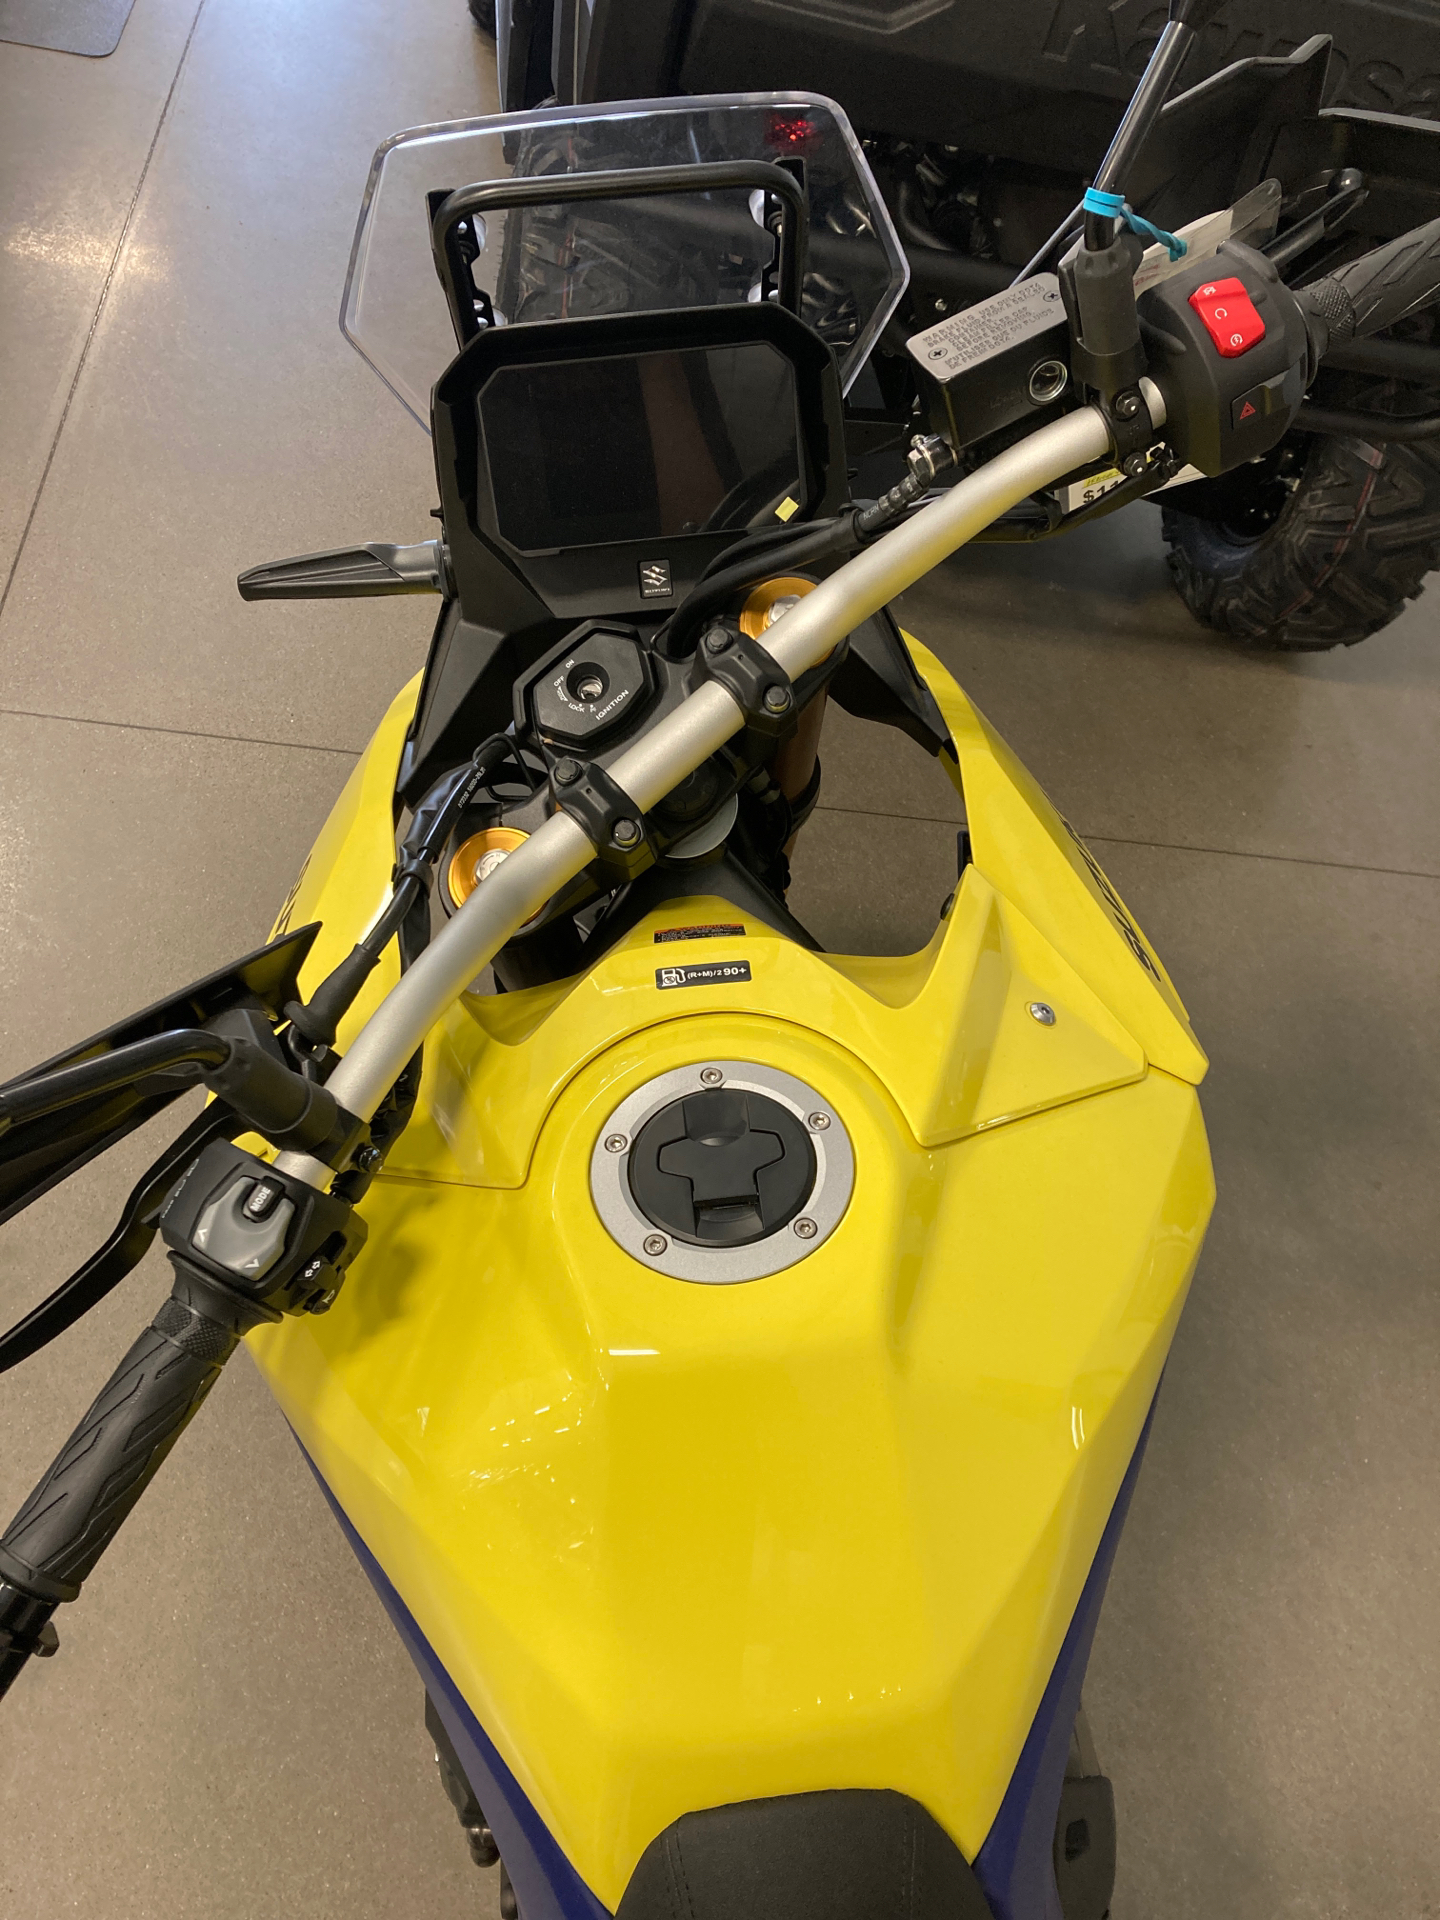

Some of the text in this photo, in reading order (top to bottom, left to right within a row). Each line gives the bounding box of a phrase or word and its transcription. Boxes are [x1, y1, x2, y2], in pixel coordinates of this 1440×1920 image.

[922, 313, 975, 344] WARNING
[978, 303, 995, 316] USE
[927, 330, 955, 348] BRAKE
[955, 317, 980, 333] FLUID
[981, 315, 1010, 333] FILLER
[955, 331, 990, 352] BEFORE
[991, 329, 1009, 342] QUE
[566, 659, 574, 668] ON
[553, 676, 564, 686] OFF
[568, 703, 585, 712] LOCK
[595, 690, 629, 720] IGNITION
[723, 967, 747, 976] 90+
[250, 1187, 271, 1212] MODE
